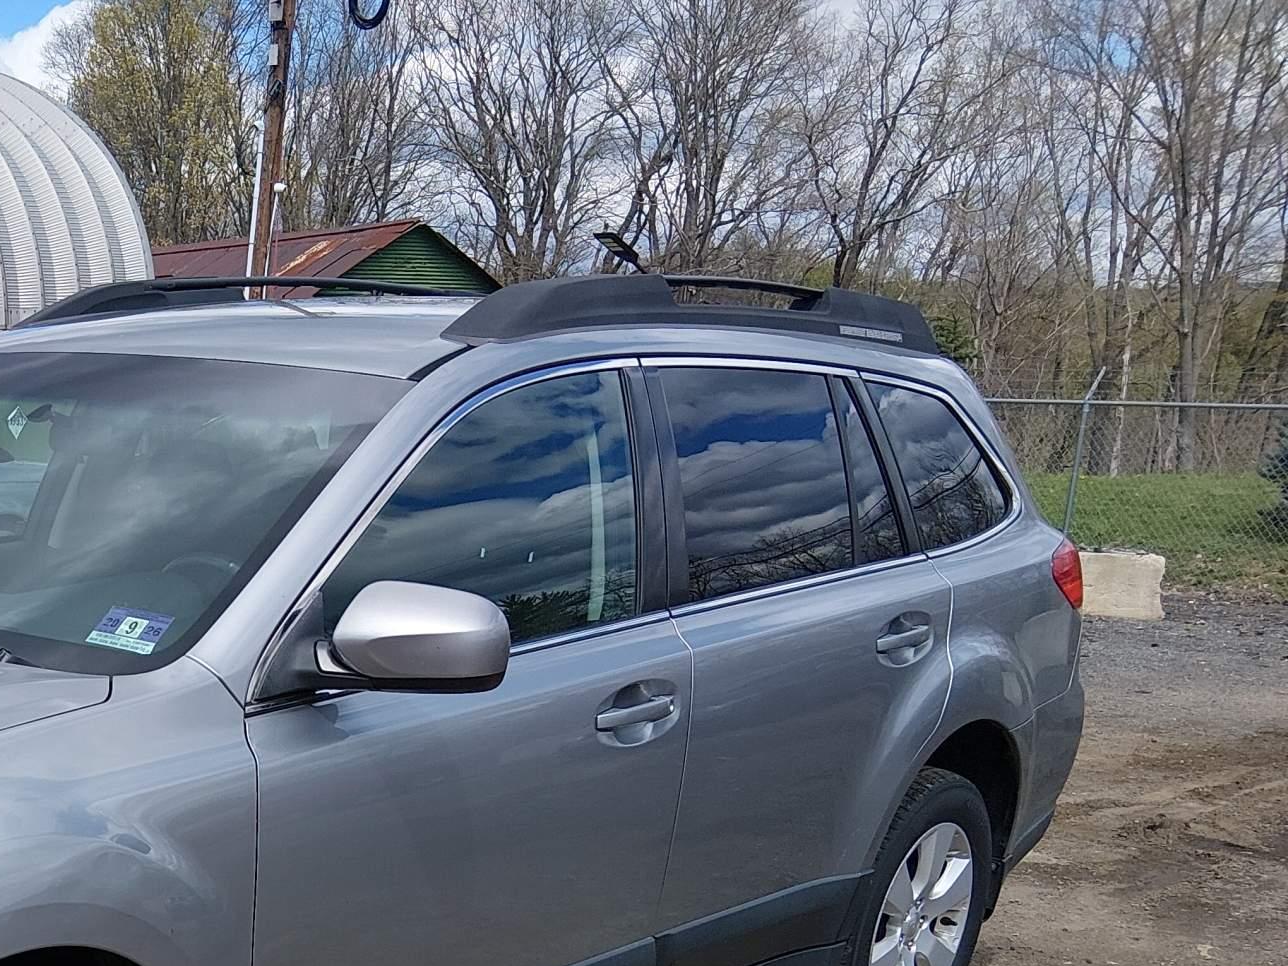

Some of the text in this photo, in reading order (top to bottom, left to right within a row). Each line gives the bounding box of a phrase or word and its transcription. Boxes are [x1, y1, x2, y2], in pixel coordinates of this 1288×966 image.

[103, 617, 162, 637] 20 9 26
